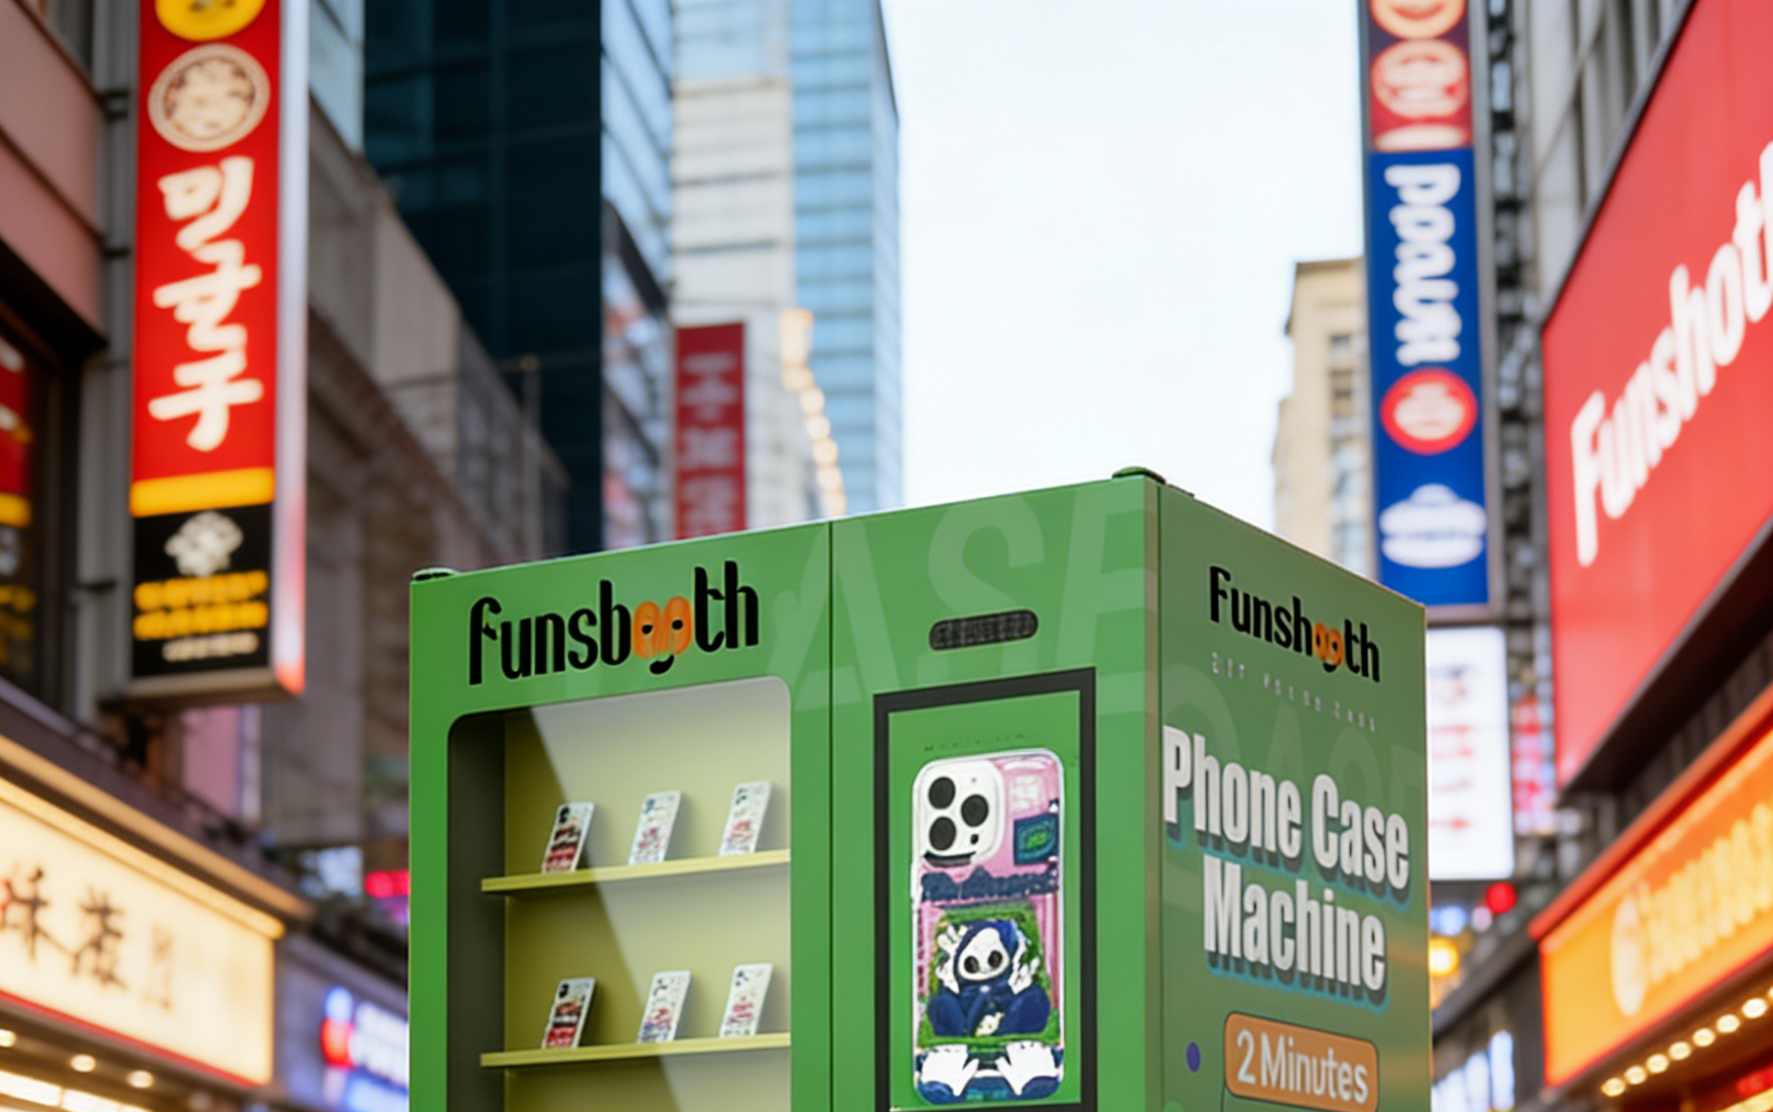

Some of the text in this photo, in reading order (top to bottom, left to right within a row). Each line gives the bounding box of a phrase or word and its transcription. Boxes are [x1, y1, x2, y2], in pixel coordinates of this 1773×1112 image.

[1163, 725, 1302, 859] Phone
[1311, 773, 1410, 890] Case
[1203, 854, 1387, 991] Machine
[1236, 1028, 1256, 1084] 2
[1260, 1032, 1369, 1104] Minutes
